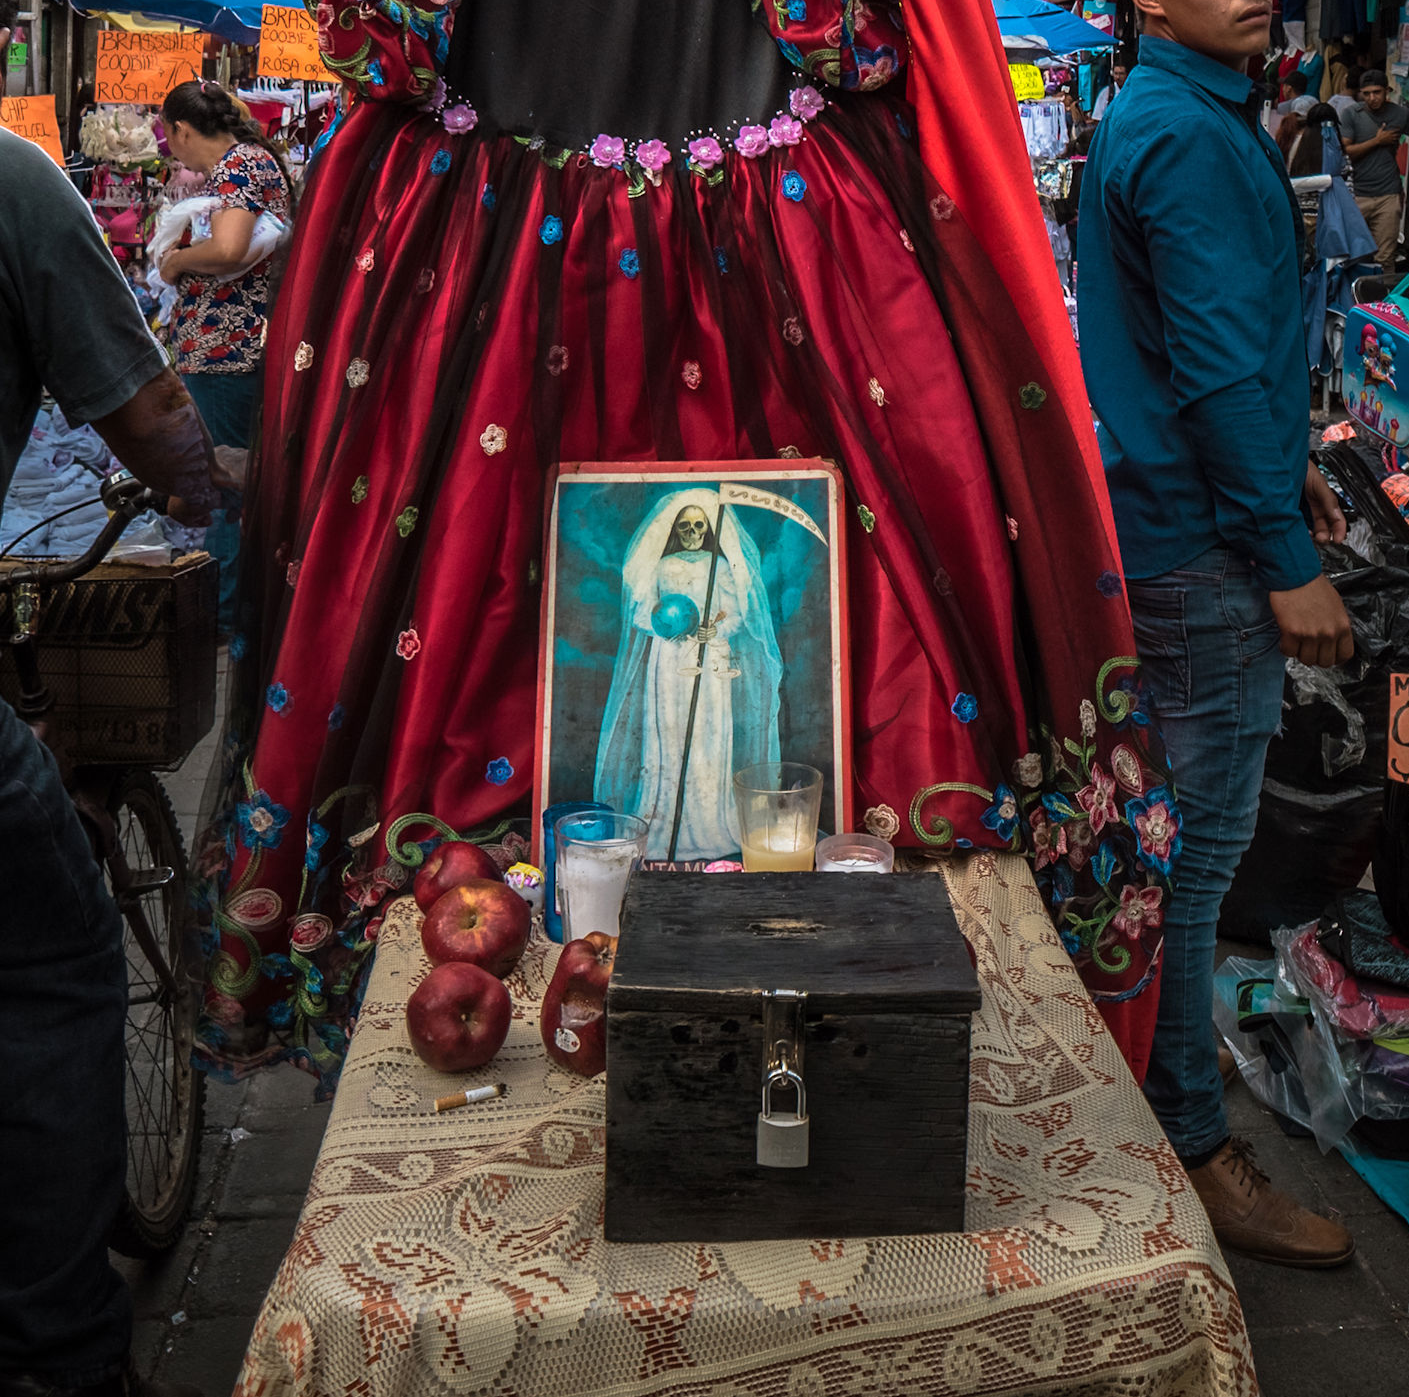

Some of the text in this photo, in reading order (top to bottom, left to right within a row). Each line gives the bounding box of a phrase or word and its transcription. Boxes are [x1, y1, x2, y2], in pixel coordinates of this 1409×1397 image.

[262, 56, 300, 74] ROSA
[97, 81, 149, 102] ROSA
[0, 97, 29, 123] CHIP
